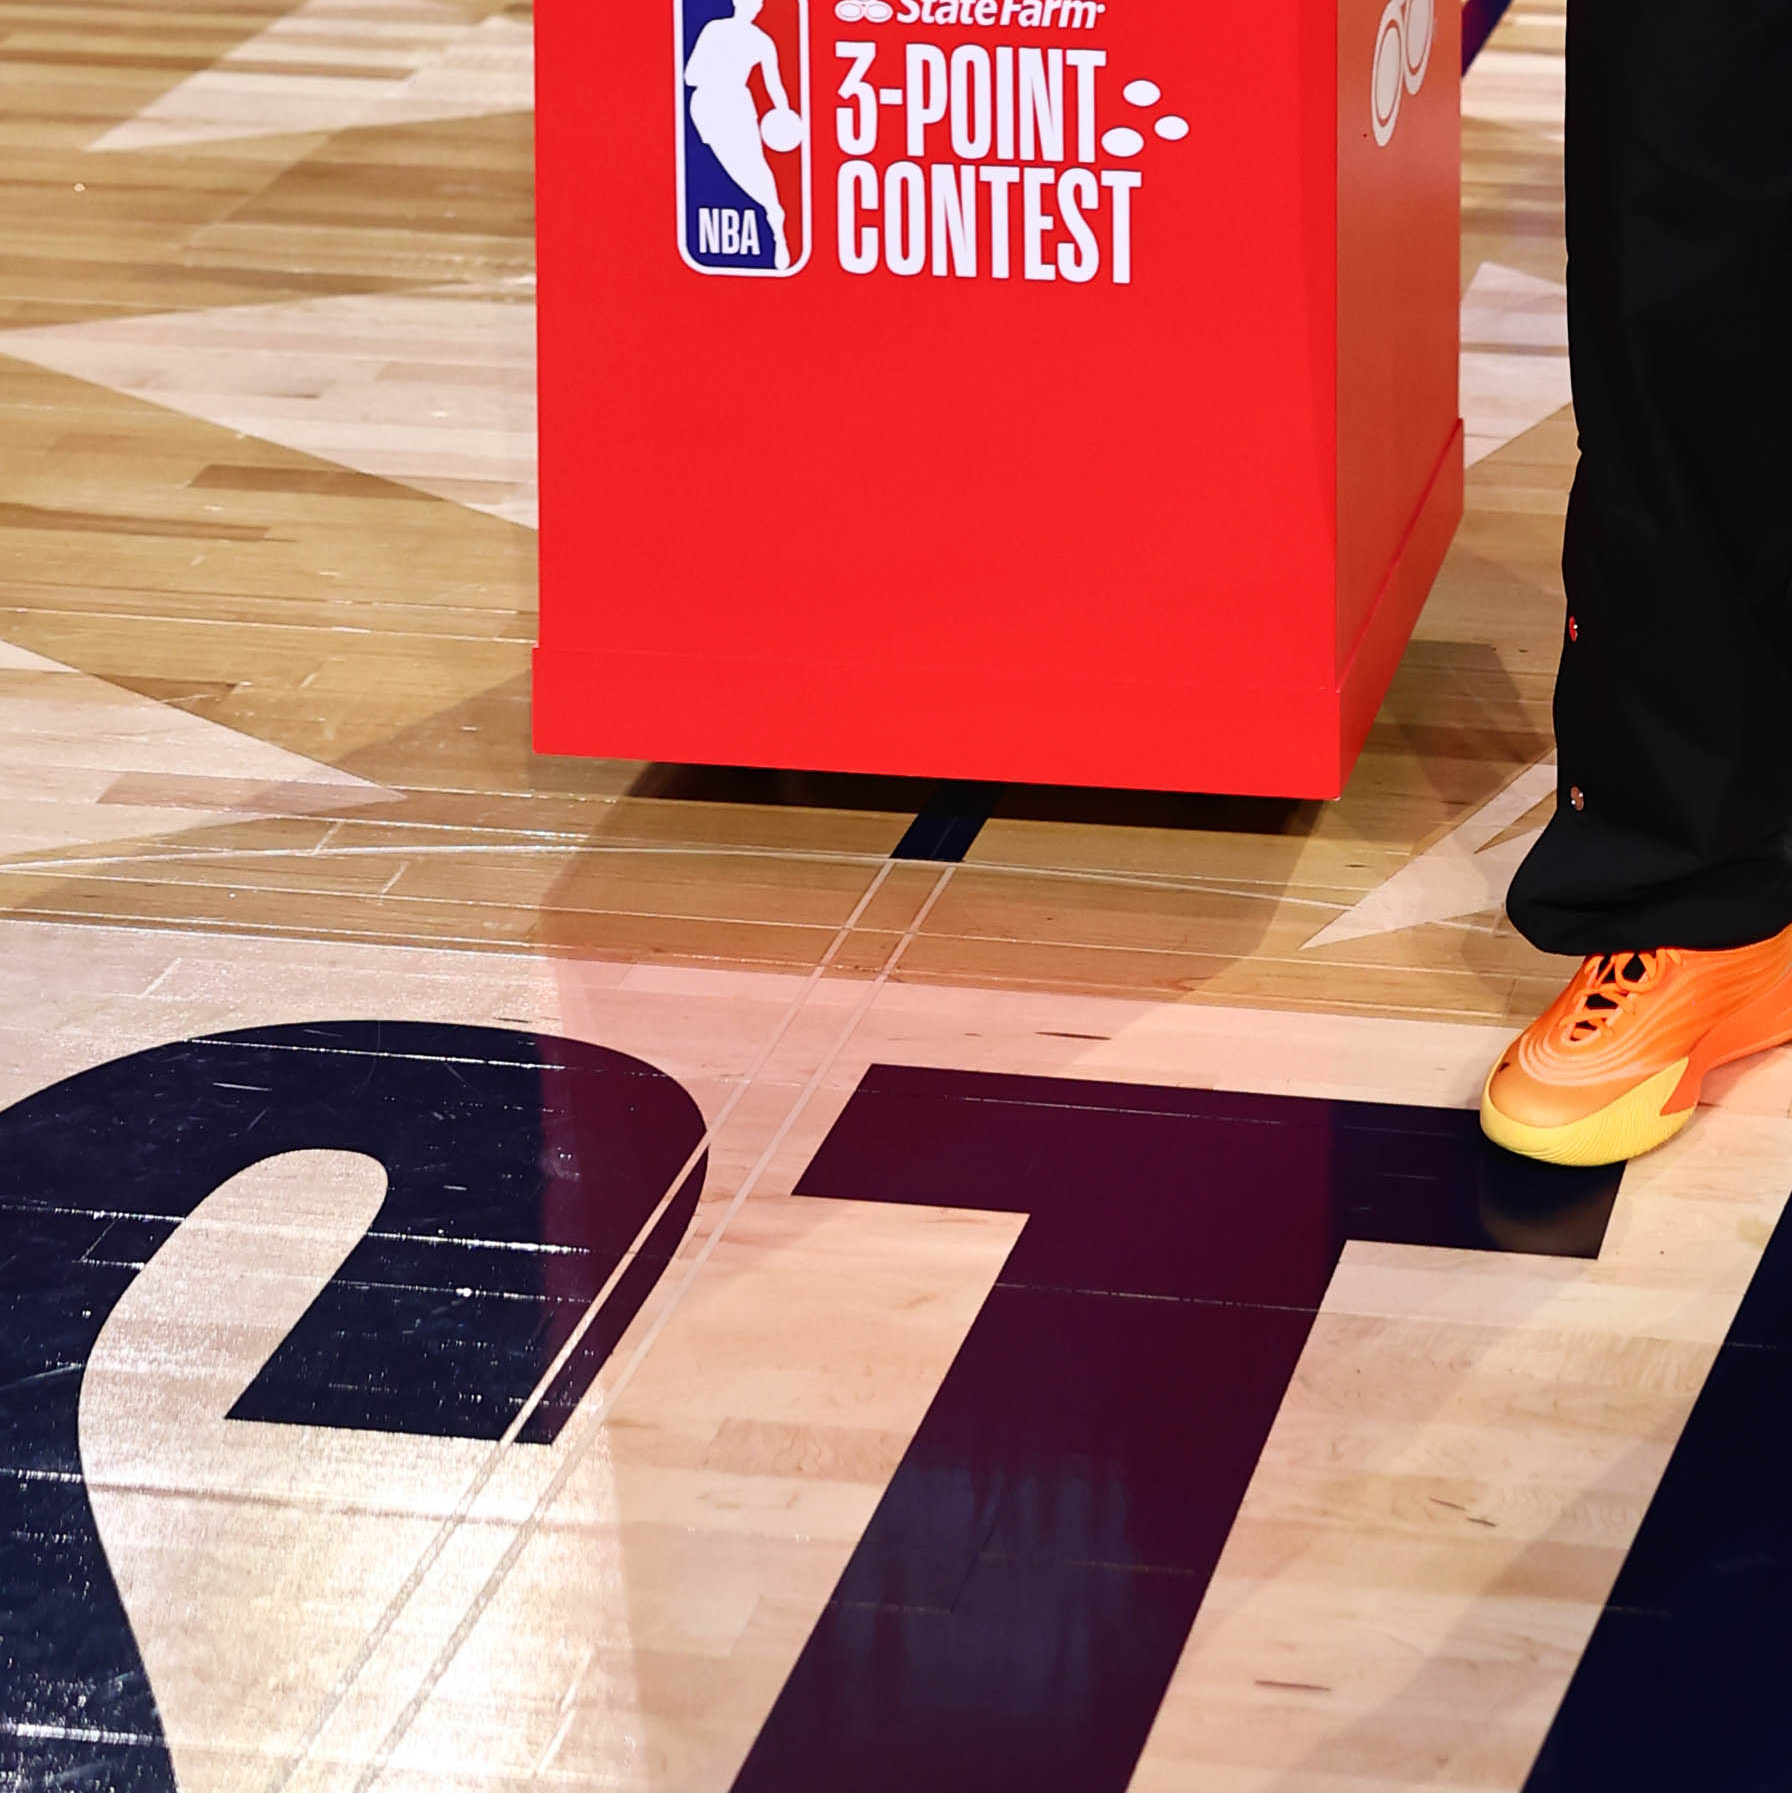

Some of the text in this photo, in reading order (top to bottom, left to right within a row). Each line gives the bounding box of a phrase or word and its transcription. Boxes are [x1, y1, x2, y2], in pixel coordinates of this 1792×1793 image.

[834, 40, 1107, 163] 3-POINT
[698, 207, 761, 255] NBA
[836, 159, 1143, 285] CONTEST
